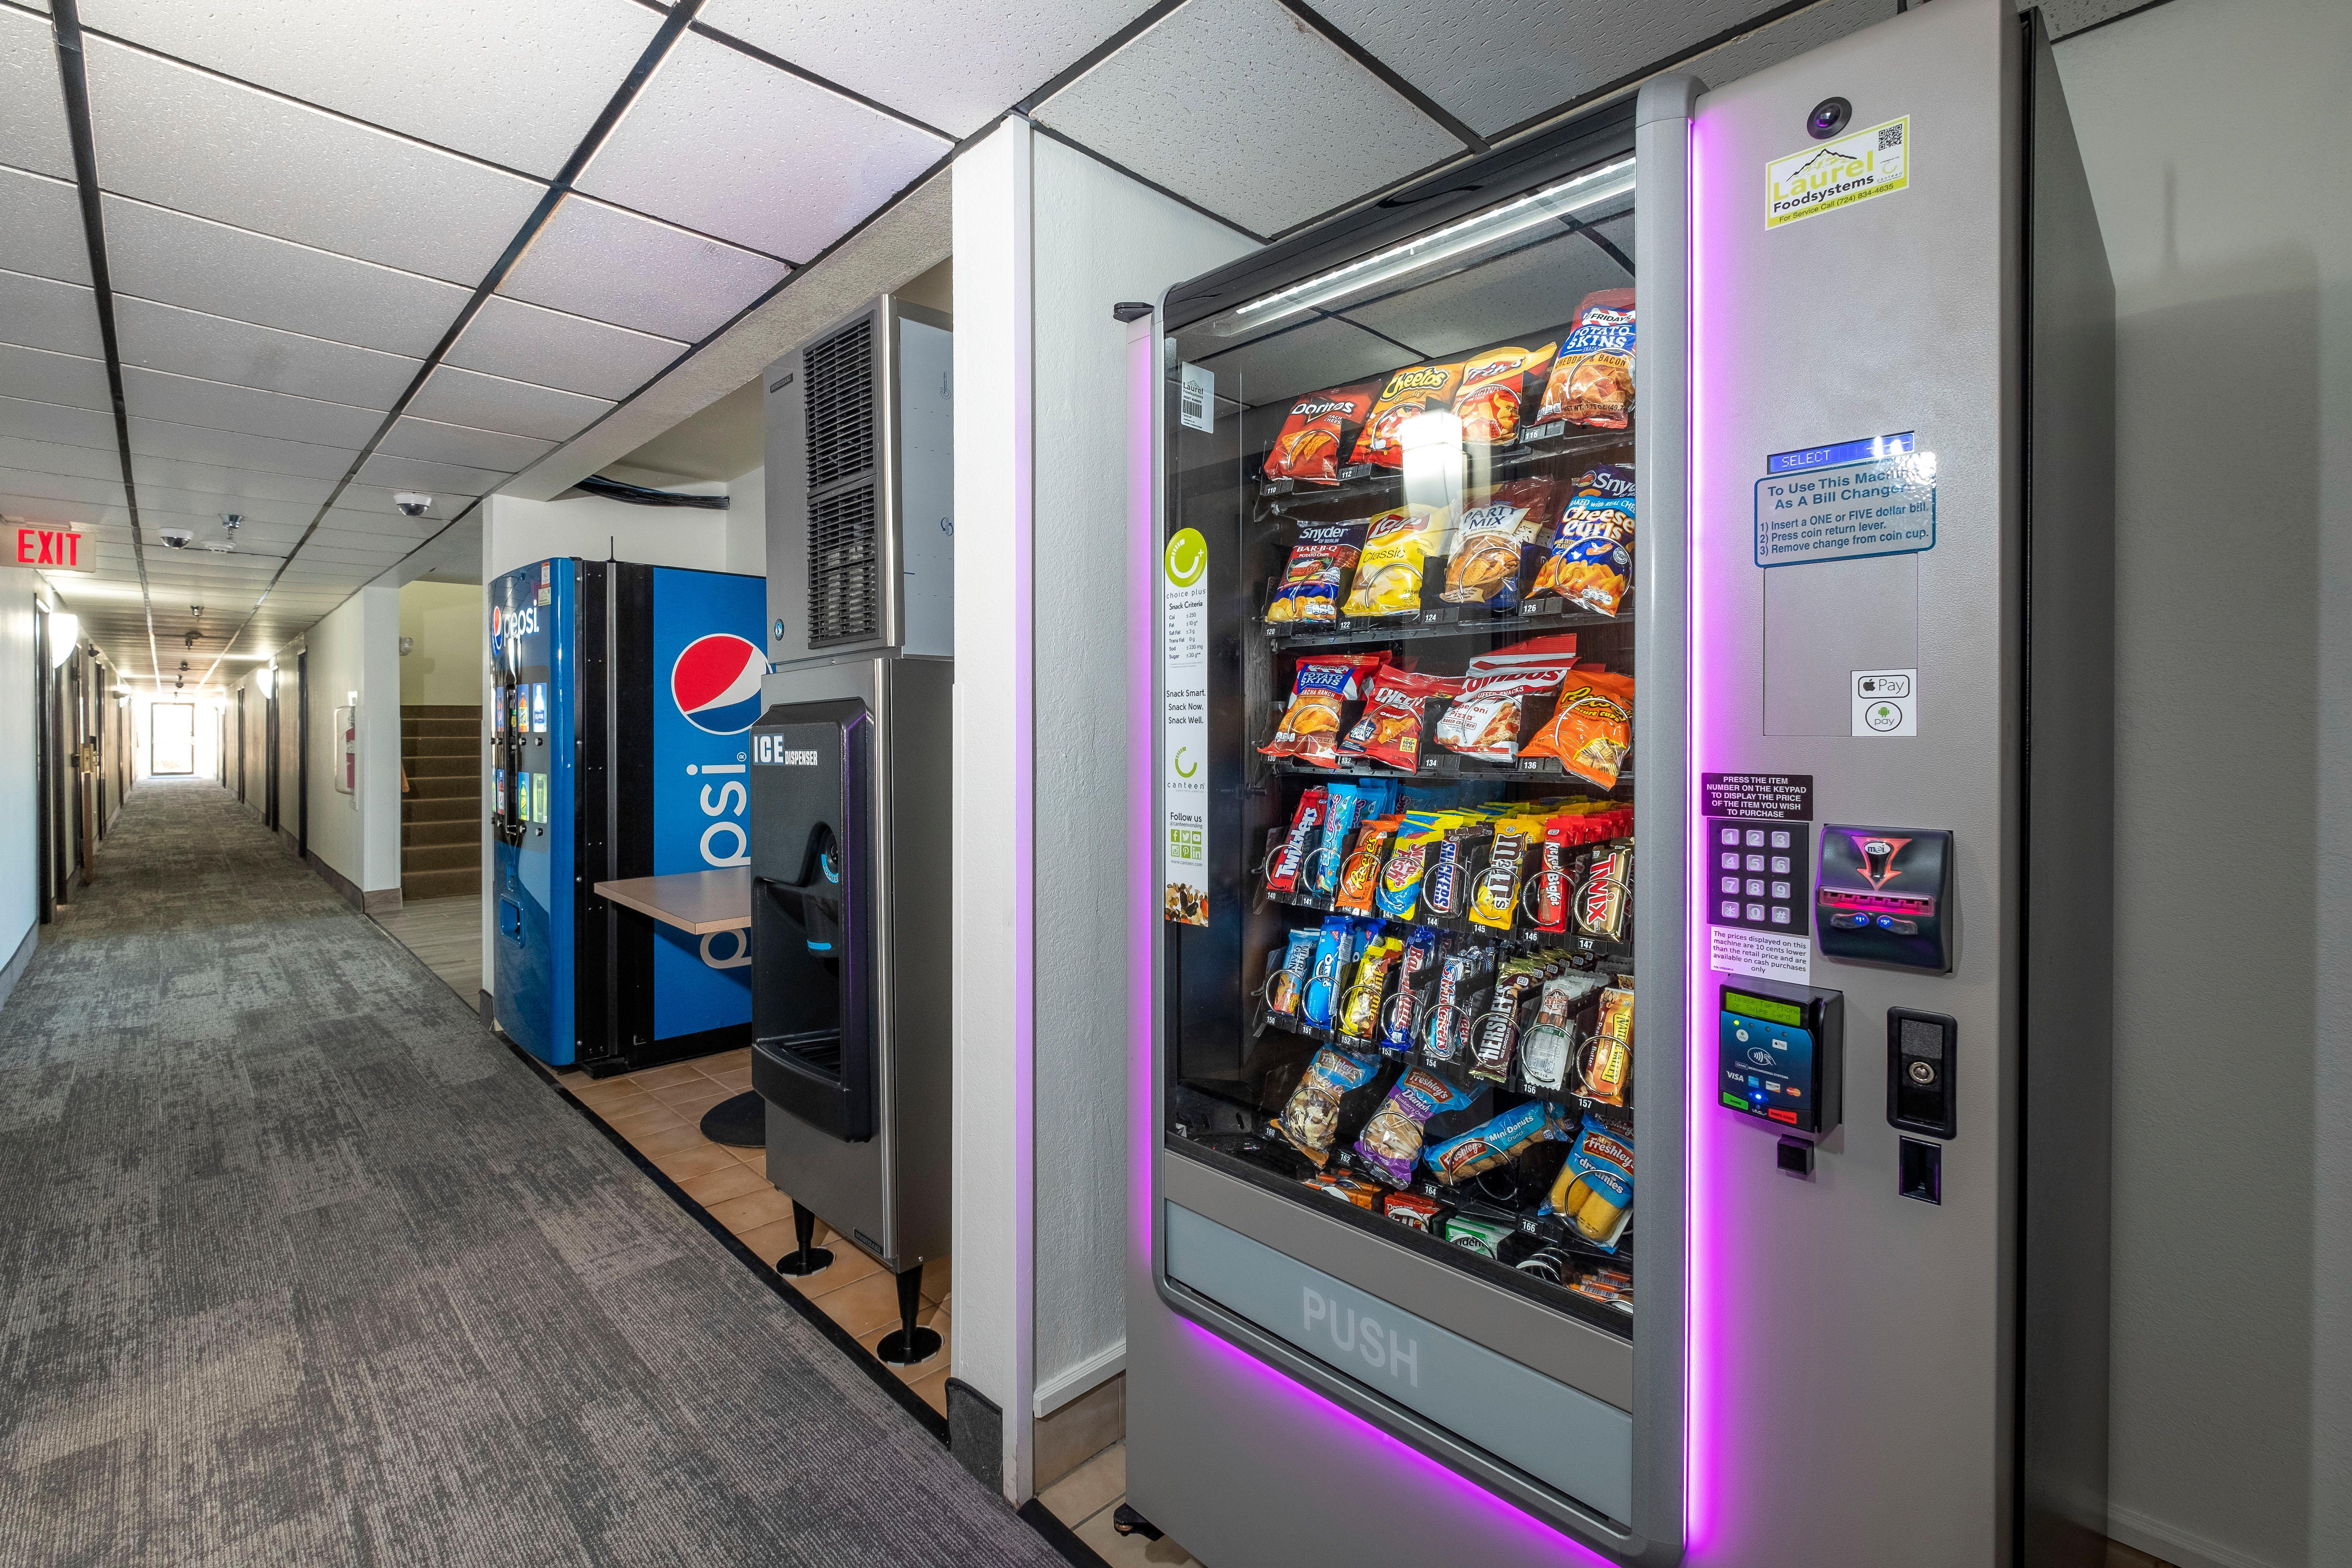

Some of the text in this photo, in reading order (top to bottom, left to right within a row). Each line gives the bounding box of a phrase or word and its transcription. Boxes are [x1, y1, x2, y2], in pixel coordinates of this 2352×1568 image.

[1773, 150, 1873, 201] Laurel
[1774, 176, 1874, 213] Foodsystems
[1780, 183, 1893, 223] For Service Call (724) 834-4635
[1574, 326, 1630, 339] POTATO
[1567, 334, 1628, 349] SKINS
[1598, 354, 1626, 367] BACON
[1183, 382, 1203, 395] Laurel
[1382, 368, 1446, 398] Cheetos
[1183, 389, 1203, 399] Foodsystems
[1291, 402, 1355, 415] Doritos
[1781, 449, 1830, 468] SELECT
[1768, 486, 1784, 497] To
[1789, 481, 1815, 494] Use
[1819, 476, 1850, 489] This
[1775, 499, 1793, 510] As
[1798, 496, 1808, 506] A
[1813, 491, 1836, 504] Bill
[1463, 506, 1519, 524] PARTY
[1469, 516, 1505, 529] MIX
[1562, 505, 1635, 534] Cheese
[1760, 522, 1768, 532] 1)
[1771, 519, 1798, 530] Insert
[1810, 514, 1832, 525] ONE
[1835, 513, 1846, 523] or
[1849, 508, 1872, 521] FIVE
[1876, 505, 1906, 517] dollar
[1909, 503, 1929, 513] bill.
[1299, 527, 1349, 539] Snyder
[1760, 520, 1886, 544] 2) Press coin return lever.
[18, 529, 81, 566] EXIT
[1760, 529, 1929, 556] 3) Remove change from coin cup.
[1363, 547, 1405, 563] Classic
[1167, 589, 1206, 599] choice plus
[1169, 600, 1203, 610] Snack Criteria
[504, 599, 539, 647] pepsi
[1301, 678, 1340, 686] SKINS
[1879, 679, 1904, 694] Pay
[1317, 690, 1335, 698] RANCH
[754, 735, 817, 765] ICE DISPENSER
[1171, 812, 1192, 822] Follow
[687, 764, 751, 969] ppsi
[1434, 841, 1456, 908] SNICKERS
[1587, 853, 1616, 924] TWIX
[1579, 941, 1593, 949] 147
[1749, 936, 1780, 946] displayed
[1786, 948, 1806, 956] lower
[1713, 953, 1742, 961] available
[1771, 962, 1806, 971] purchases
[1729, 994, 1756, 1005] Please
[1777, 1005, 1799, 1015] Phone
[1746, 1005, 1768, 1014] Swipe
[1772, 1011, 1791, 1020] Card
[1726, 1071, 1744, 1082] VISA
[1410, 1072, 1448, 1099] Freshley's
[1402, 1089, 1431, 1112] Danish
[1579, 1098, 1592, 1108] 157
[1489, 1115, 1534, 1142] Mini Donuts
[1507, 1130, 1524, 1142] Crunch
[1425, 1186, 1436, 1196] 164
[1523, 1220, 1535, 1232] 166
[1303, 1286, 1417, 1388] PUSH
